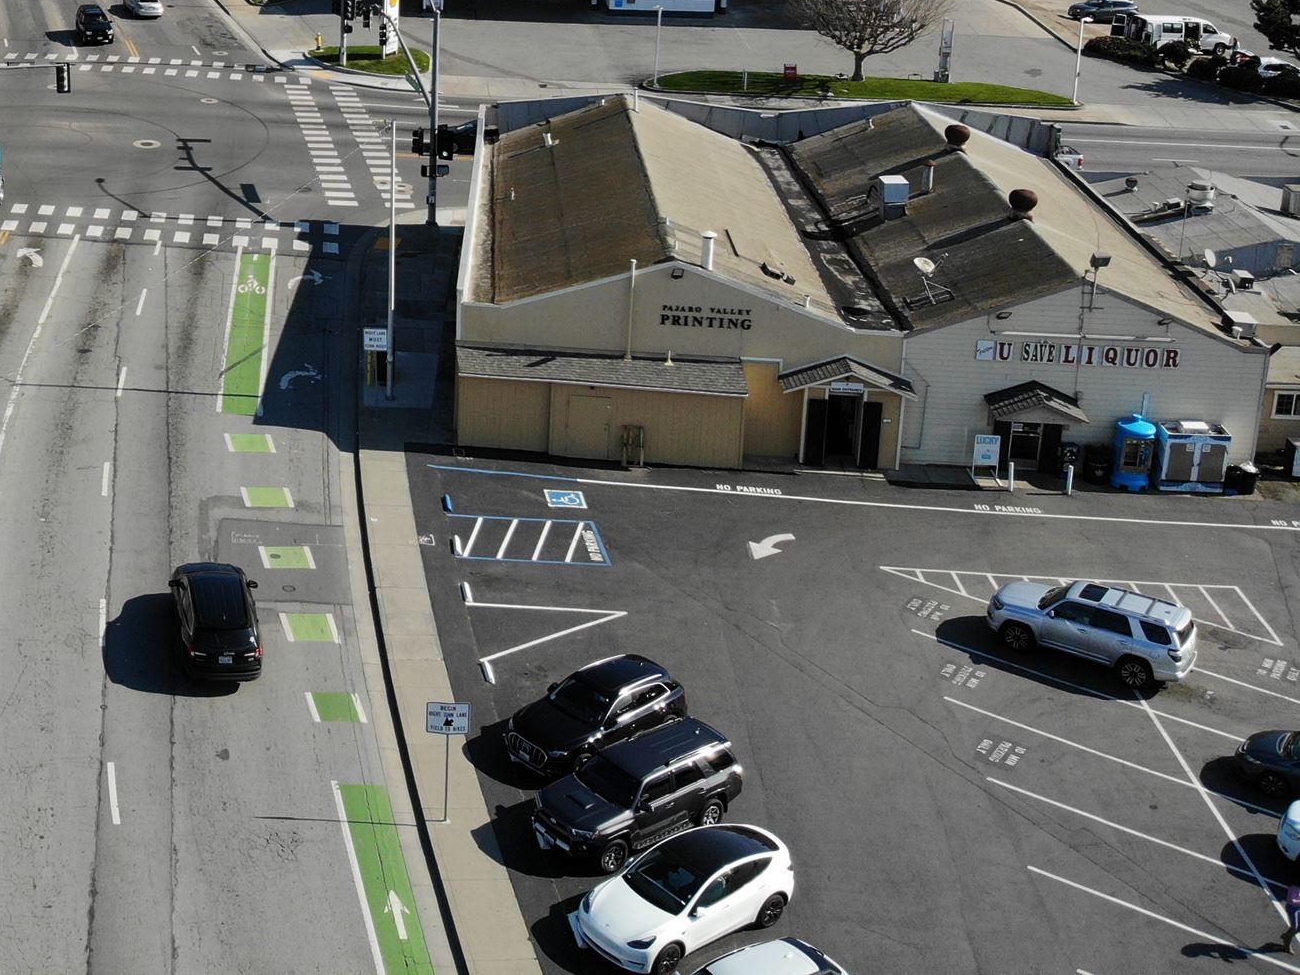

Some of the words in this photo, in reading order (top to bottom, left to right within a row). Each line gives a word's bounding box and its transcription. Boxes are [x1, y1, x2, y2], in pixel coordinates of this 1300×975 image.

[662, 305, 702, 314] PAJARO
[709, 307, 752, 316] VALLEY
[660, 314, 752, 331] PRINTING
[998, 342, 1013, 361] U
[1022, 343, 1056, 363] SAVE
[1062, 345, 1180, 368] LIQUOR
[715, 483, 732, 491] NO
[735, 485, 782, 495] PARKING
[973, 503, 990, 511] NO
[994, 505, 1042, 514] PARKING
[1270, 519, 1288, 527] NO
[430, 724, 444, 732] YIELD
